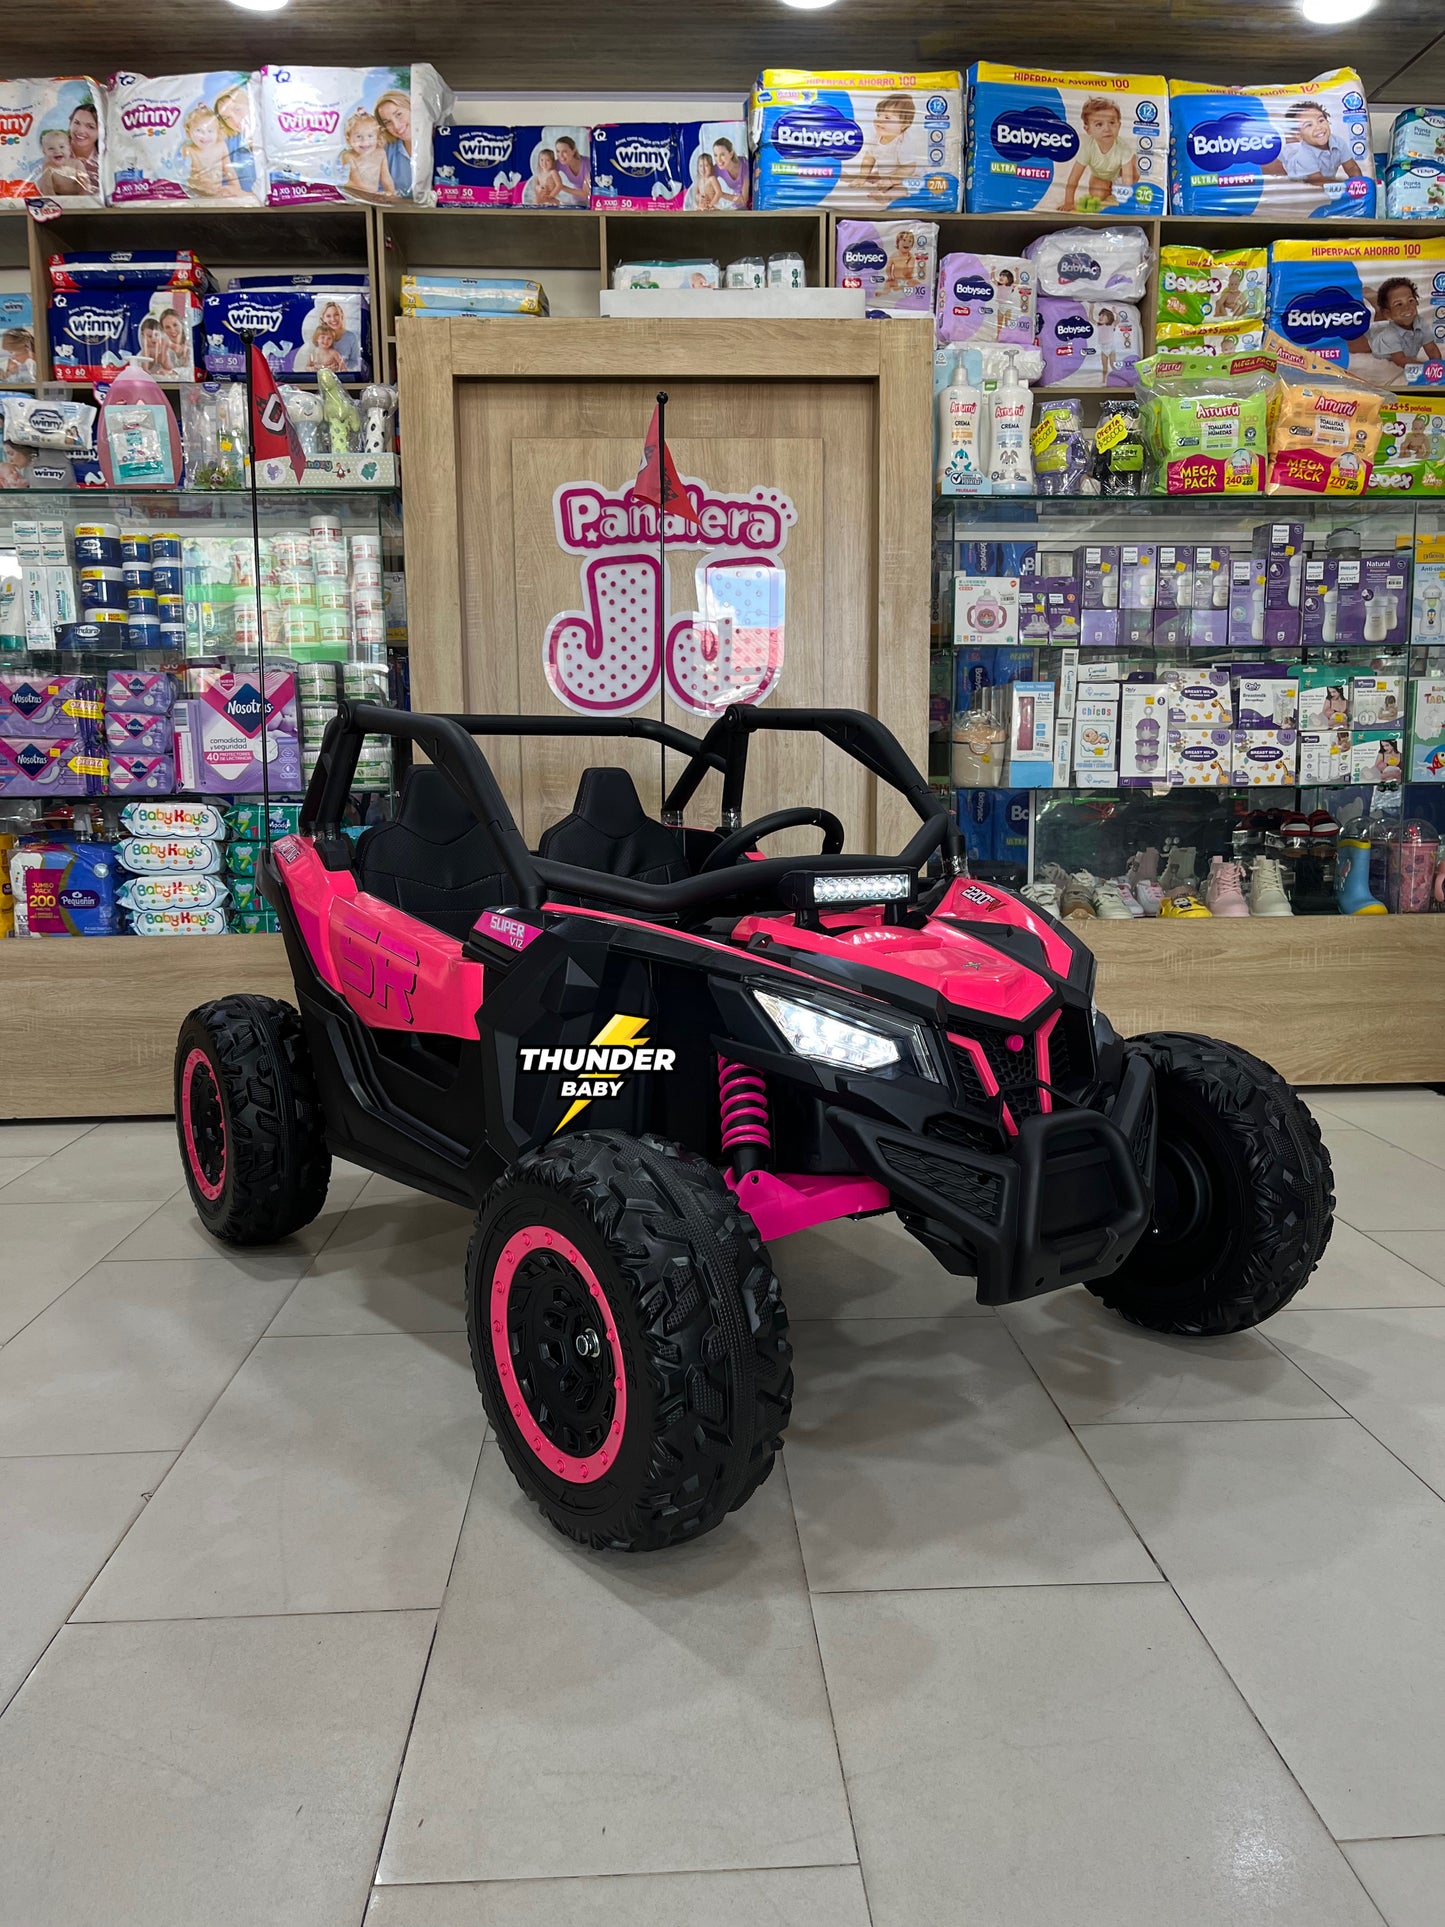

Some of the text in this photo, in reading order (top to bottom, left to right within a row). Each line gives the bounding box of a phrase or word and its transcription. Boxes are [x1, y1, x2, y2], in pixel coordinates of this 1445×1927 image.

[859, 78, 895, 86] AHORRO
[899, 75, 916, 86] 100
[1111, 79, 1130, 89] 100
[123, 105, 180, 130] winny
[280, 108, 339, 132] winny
[778, 126, 855, 147] Babysec
[997, 125, 1072, 148] Babysec
[460, 139, 512, 160] winny
[1193, 134, 1275, 155] Babysec
[618, 145, 670, 170] winny
[991, 163, 1051, 179] ULTRA PROTECT
[928, 180, 947, 190] 2/M
[1191, 174, 1255, 186] ULTRA PROTECT
[292, 186, 307, 196] 100
[462, 188, 473, 197] 50
[1136, 191, 1153, 202] 3/G
[596, 200, 601, 208] 6
[621, 200, 632, 208] 50
[1312, 244, 1421, 257] HIPERPACK AHORRO 100
[845, 252, 883, 263] Babysec
[1164, 272, 1221, 293] Bebex
[915, 286, 926, 295] XG
[956, 284, 992, 296] Babysec
[71, 313, 122, 337] winny
[229, 309, 282, 330] winny
[1287, 310, 1364, 330] Babysec
[1057, 325, 1091, 335] Babysec
[1425, 367, 1444, 378] 4/XG
[1197, 403, 1240, 418] Arrurrú
[1315, 396, 1357, 416] Arrurrú
[32, 417, 62, 428] winny
[1320, 418, 1344, 427] TOALLITAS
[1181, 465, 1218, 478] MEGA
[1288, 459, 1325, 472] MEGA
[34, 469, 65, 480] winny
[1226, 476, 1241, 485] 240
[1288, 469, 1322, 483] PACK
[1184, 477, 1217, 489] PACK
[1330, 476, 1346, 487] 270
[12, 694, 42, 705] Nosotras
[1082, 705, 1111, 716] chicos
[17, 755, 48, 765] Nosotras
[206, 752, 219, 761] 40
[138, 808, 209, 826] Baby Kay's
[132, 843, 203, 859] Baby Kay's
[137, 883, 171, 897] Baby
[29, 895, 57, 907] 200
[60, 895, 95, 907] Pequeñín
[145, 912, 215, 926] Baby Kay's
[490, 915, 525, 938] SUPER
